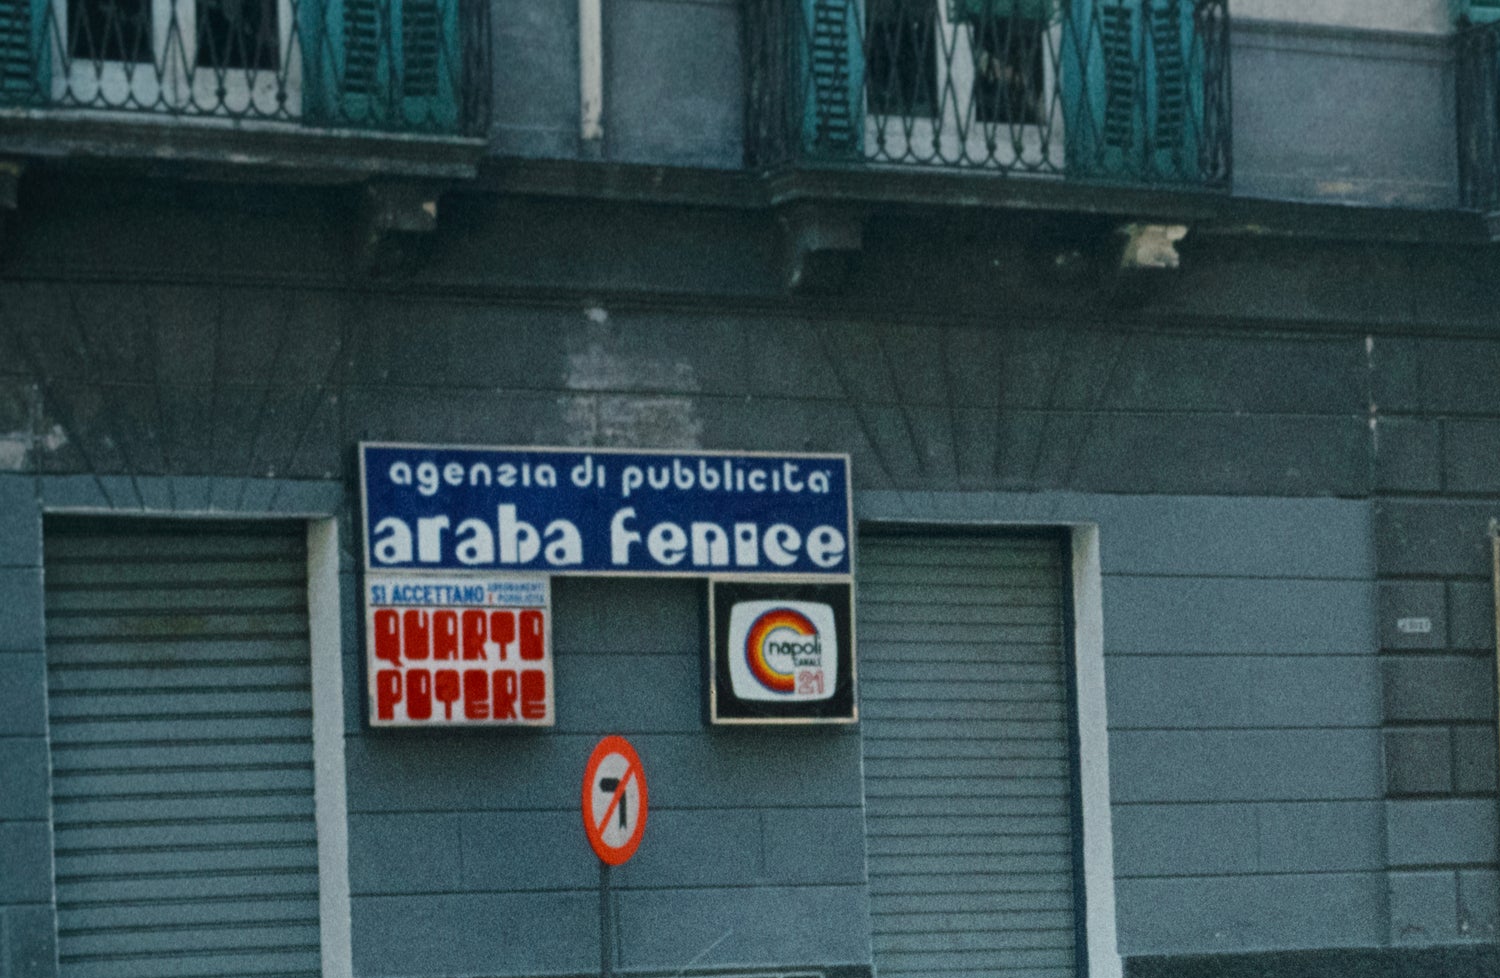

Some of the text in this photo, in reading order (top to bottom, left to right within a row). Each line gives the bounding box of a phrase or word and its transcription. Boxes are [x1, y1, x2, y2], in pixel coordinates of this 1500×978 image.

[389, 461, 557, 496] agenzia
[571, 455, 605, 488] di
[373, 503, 846, 568] araba fenice
[371, 585, 387, 604] SI
[391, 585, 485, 604] ACCETTANO
[374, 609, 544, 668] QUARTO
[769, 634, 822, 661] napoli
[376, 668, 546, 720] POTERE
[798, 669, 825, 695] 21
